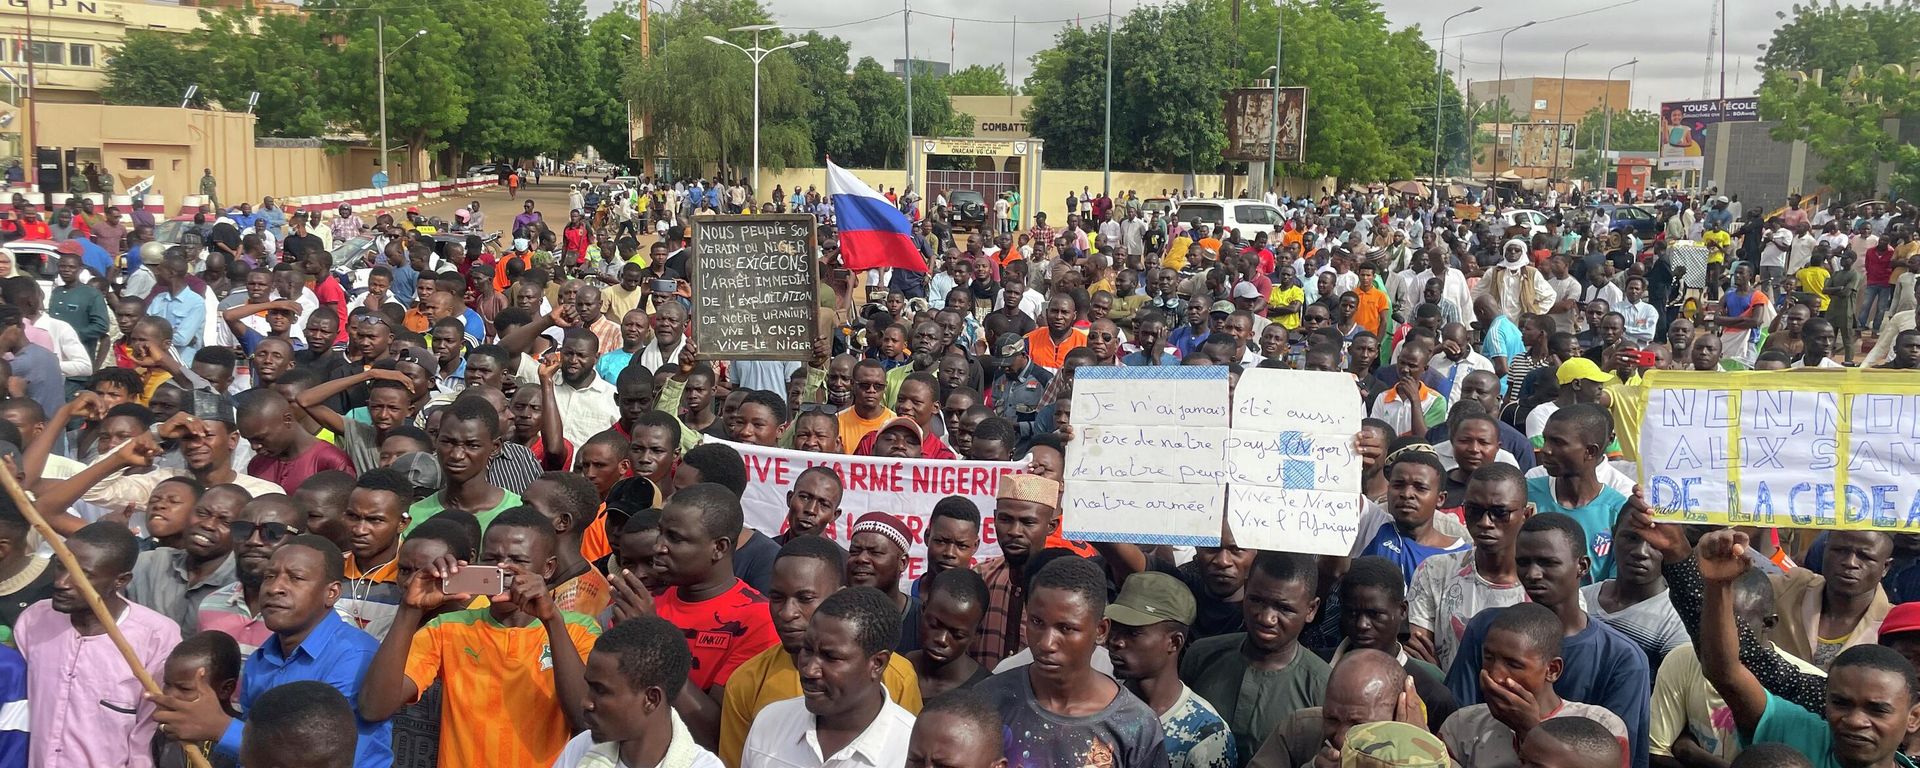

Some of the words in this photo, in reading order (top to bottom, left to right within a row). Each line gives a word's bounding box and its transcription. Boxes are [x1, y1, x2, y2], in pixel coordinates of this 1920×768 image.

[1682, 104, 1708, 112] TOUS
[1719, 101, 1757, 110] ÉCOLE
[700, 225, 734, 241] NOUS
[699, 243, 739, 254] VERAIN
[745, 243, 758, 252] DU
[701, 258, 732, 270] NOUS
[736, 254, 809, 272] EXIGEONS
[703, 296, 720, 307] DE
[703, 315, 716, 325] DE
[751, 324, 762, 336] LA
[768, 325, 806, 336] CNSP
[754, 337, 767, 349] LE
[776, 337, 812, 350] NIGER
[1080, 391, 1118, 421] Je
[1663, 389, 1803, 435] NON,
[1815, 392, 1920, 439] NO
[1135, 429, 1157, 446] de
[1161, 432, 1213, 450] notre
[744, 455, 790, 485] IVE
[912, 466, 1033, 497] NIGERI
[1072, 457, 1089, 477] de
[1100, 456, 1171, 477] notre
[1267, 464, 1287, 482] et
[1318, 464, 1339, 484] de
[1073, 491, 1141, 511] notre
[1278, 489, 1296, 507] le
[1651, 475, 1708, 521] DE
[1728, 480, 1775, 523] LA
[699, 633, 727, 646] UNKUT
